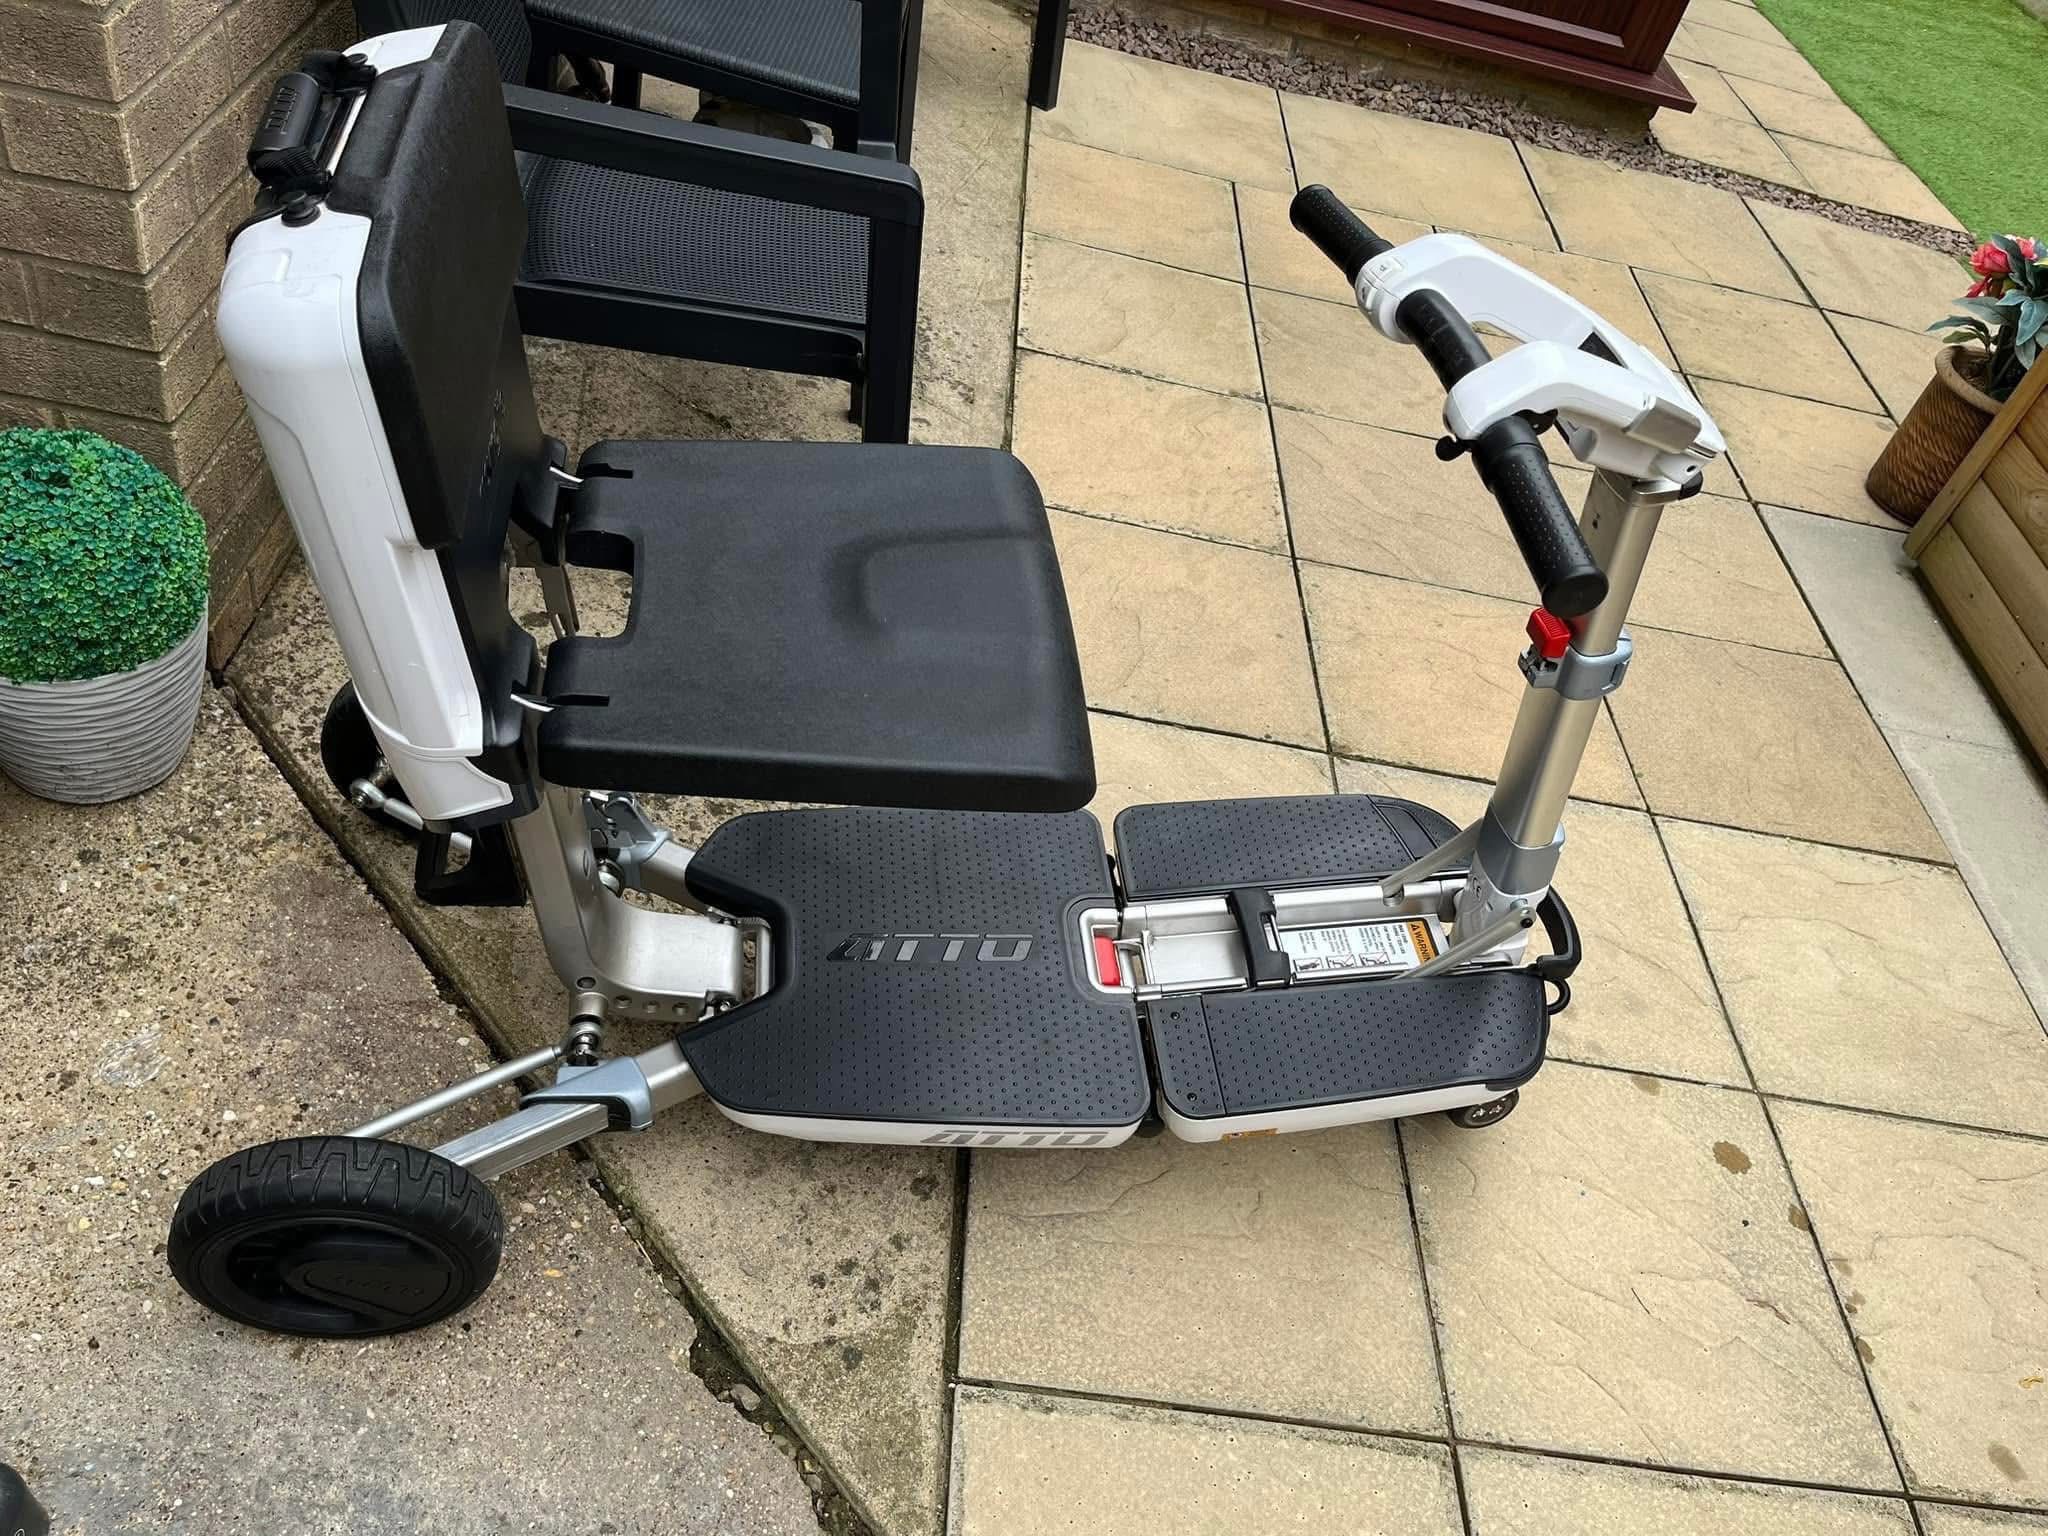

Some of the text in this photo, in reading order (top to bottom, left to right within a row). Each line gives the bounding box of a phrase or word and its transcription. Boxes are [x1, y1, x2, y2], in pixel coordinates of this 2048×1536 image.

[826, 933, 1033, 962] ATTO
[1413, 931, 1431, 961] WARNIN
[920, 1130, 1109, 1146] ATTO
